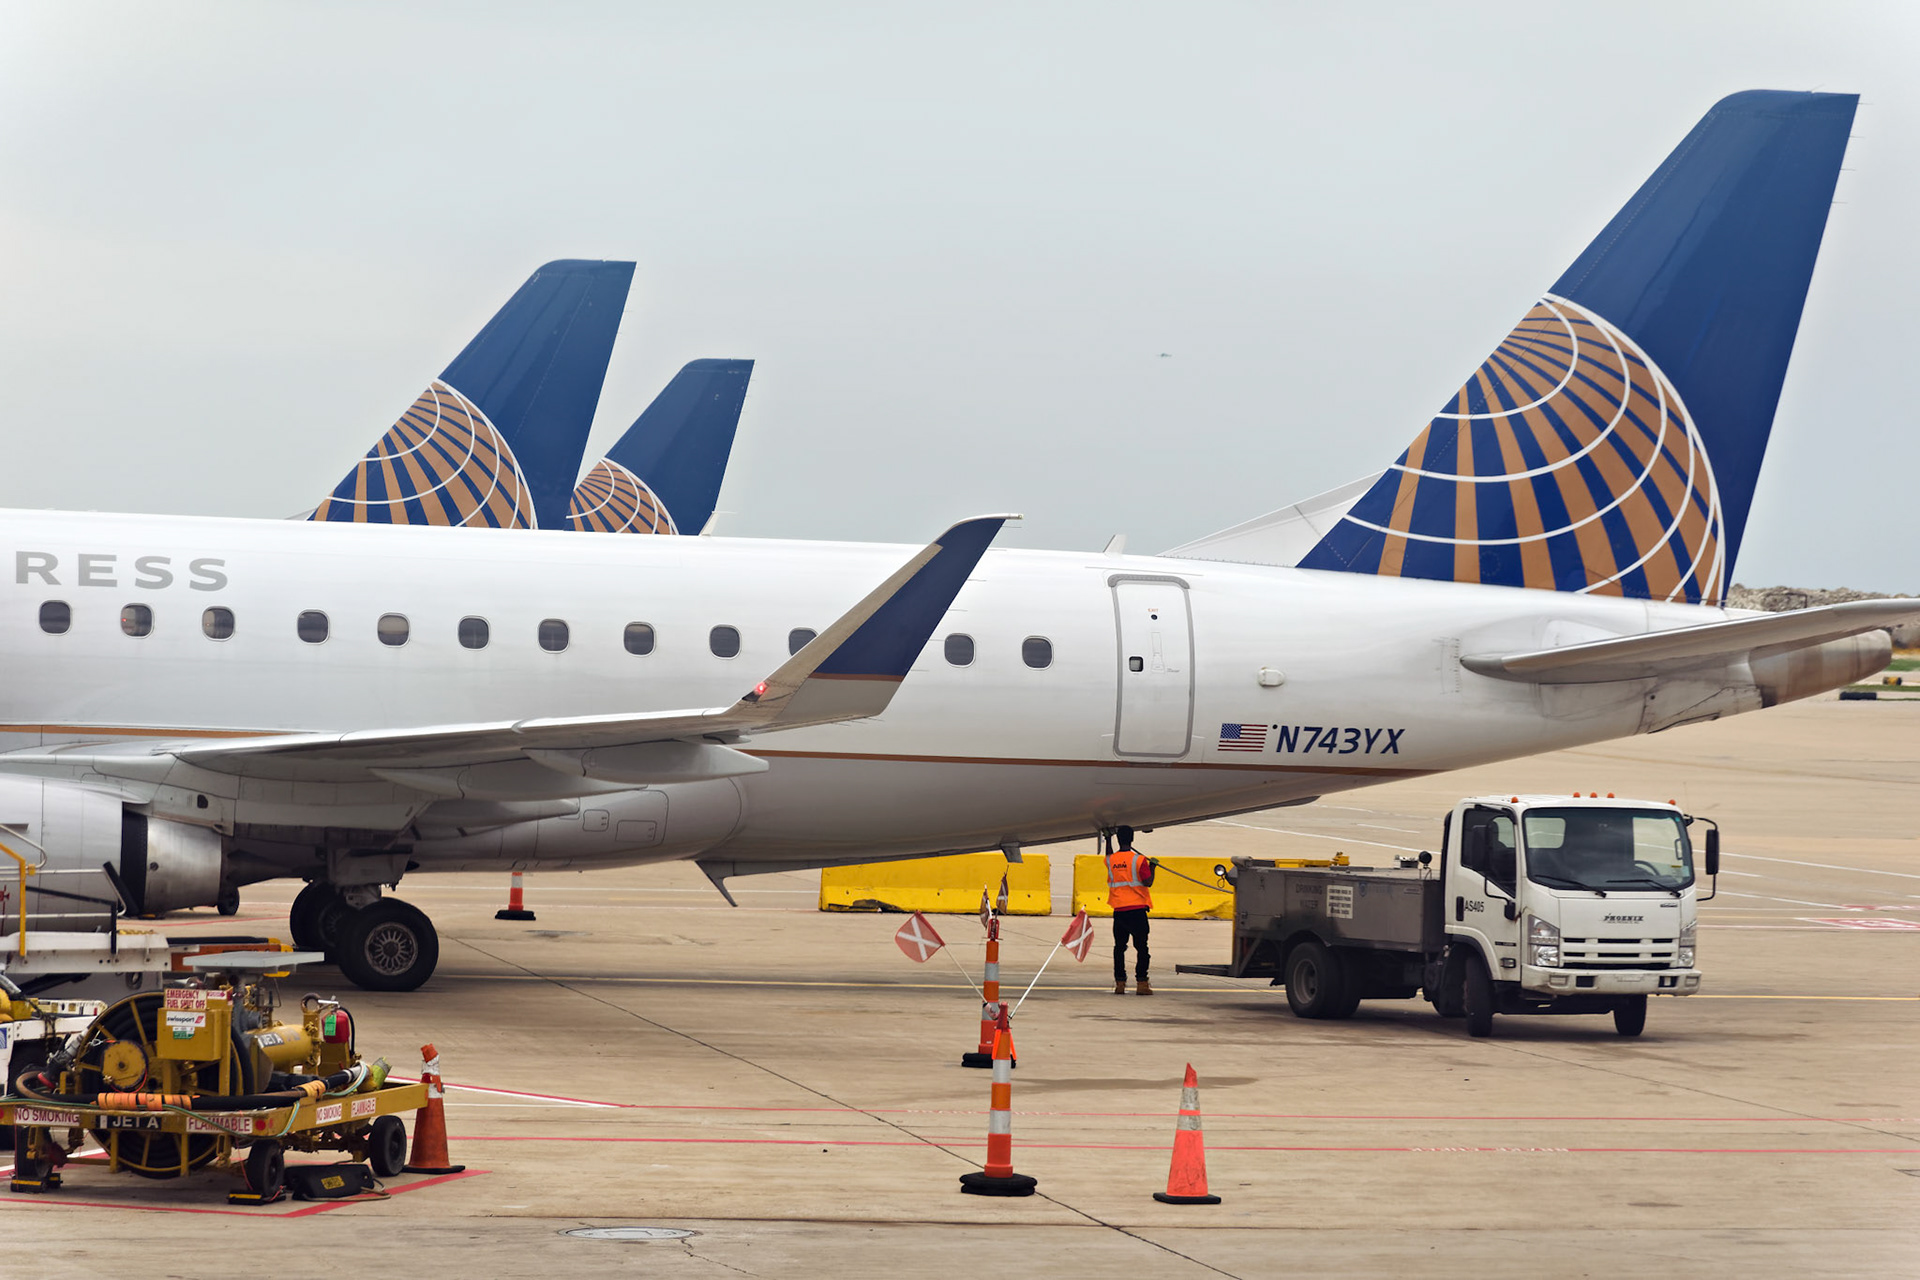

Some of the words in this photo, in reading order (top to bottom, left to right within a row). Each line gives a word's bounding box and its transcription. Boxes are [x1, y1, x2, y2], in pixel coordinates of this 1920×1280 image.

[15, 550, 228, 592] RESS
[1275, 725, 1406, 755] N743YX
[1464, 900, 1485, 913] AS405
[1603, 914, 1644, 922] PHOENIX
[166, 989, 199, 999] EMERGENCY
[167, 999, 179, 1008] FUEL
[195, 1000, 206, 1009] OFF
[167, 1014, 195, 1024] swissport
[15, 1107, 30, 1121] NO
[32, 1109, 80, 1123] SMOKING
[112, 1115, 141, 1128] JET
[147, 1115, 159, 1129] A
[188, 1117, 251, 1132] FLAMMABLE
